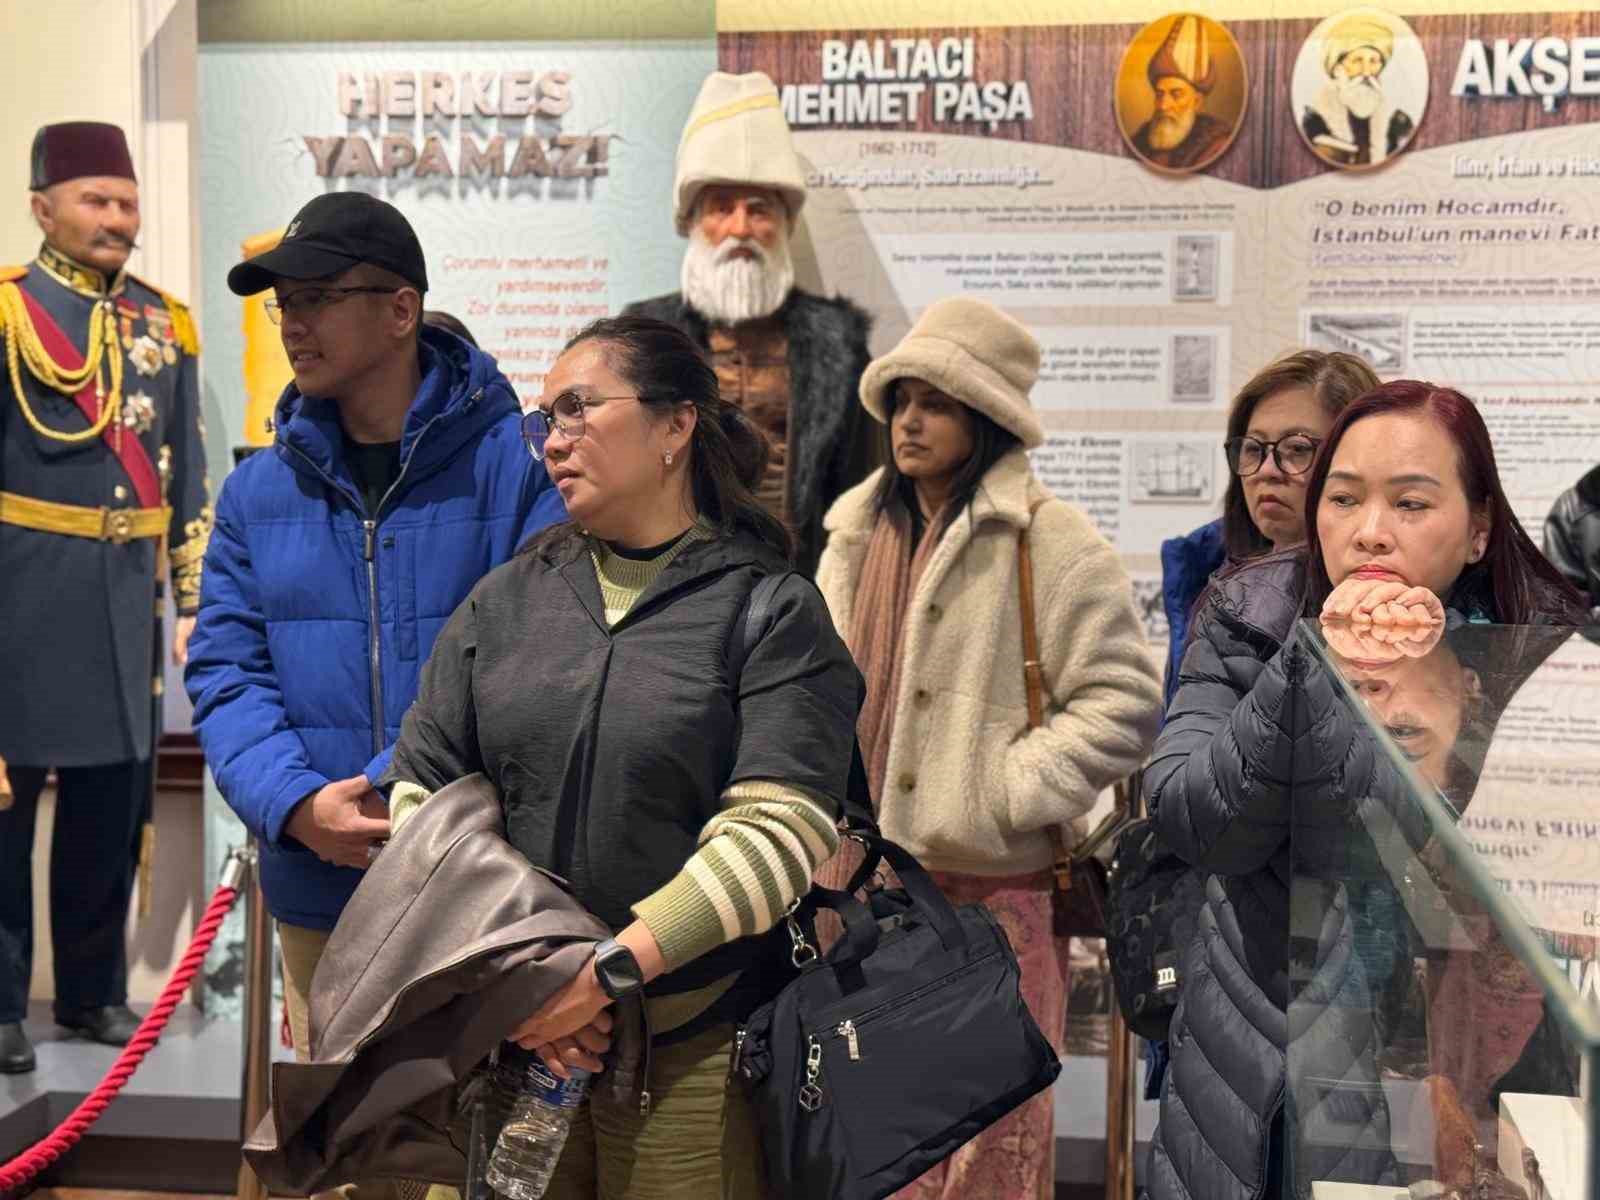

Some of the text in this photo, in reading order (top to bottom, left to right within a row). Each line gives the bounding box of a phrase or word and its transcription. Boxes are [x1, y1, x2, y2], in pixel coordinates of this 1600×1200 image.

[822, 38, 974, 79] BALTACI
[1450, 37, 1600, 112] AKŞE
[337, 70, 571, 121] HERKES
[935, 81, 1033, 132] PAŞA
[303, 134, 609, 177] YAPAMAZ!
[1351, 200, 1427, 216] benim
[1459, 227, 1550, 241] manevi
